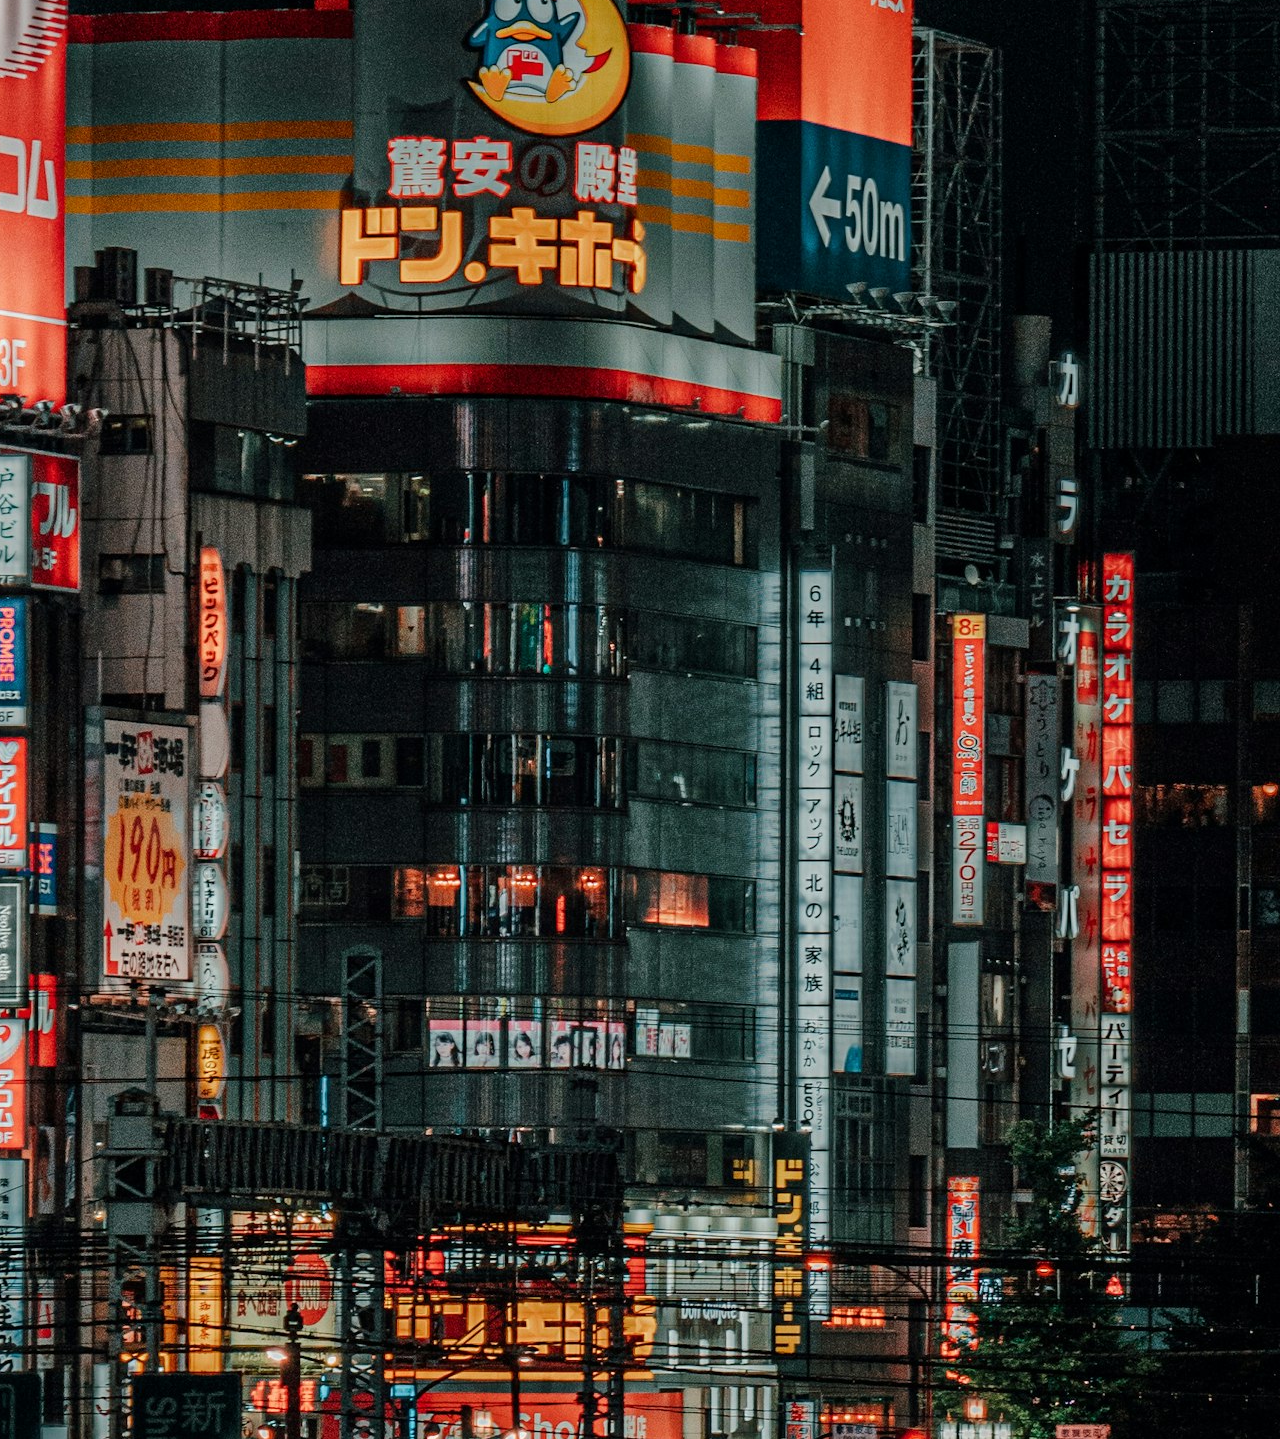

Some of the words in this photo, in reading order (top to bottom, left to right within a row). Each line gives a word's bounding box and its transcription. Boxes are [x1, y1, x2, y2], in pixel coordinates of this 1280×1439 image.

[386, 134, 640, 207] 驚安の殿堂
[845, 174, 906, 262] 50m
[958, 617, 980, 637] 8F
[1104, 574, 1132, 903] カラオケパセラ
[202, 1046, 220, 1083] 虎の子
[1104, 1021, 1125, 1129] パーティー
[680, 1297, 700, 1321] Don
